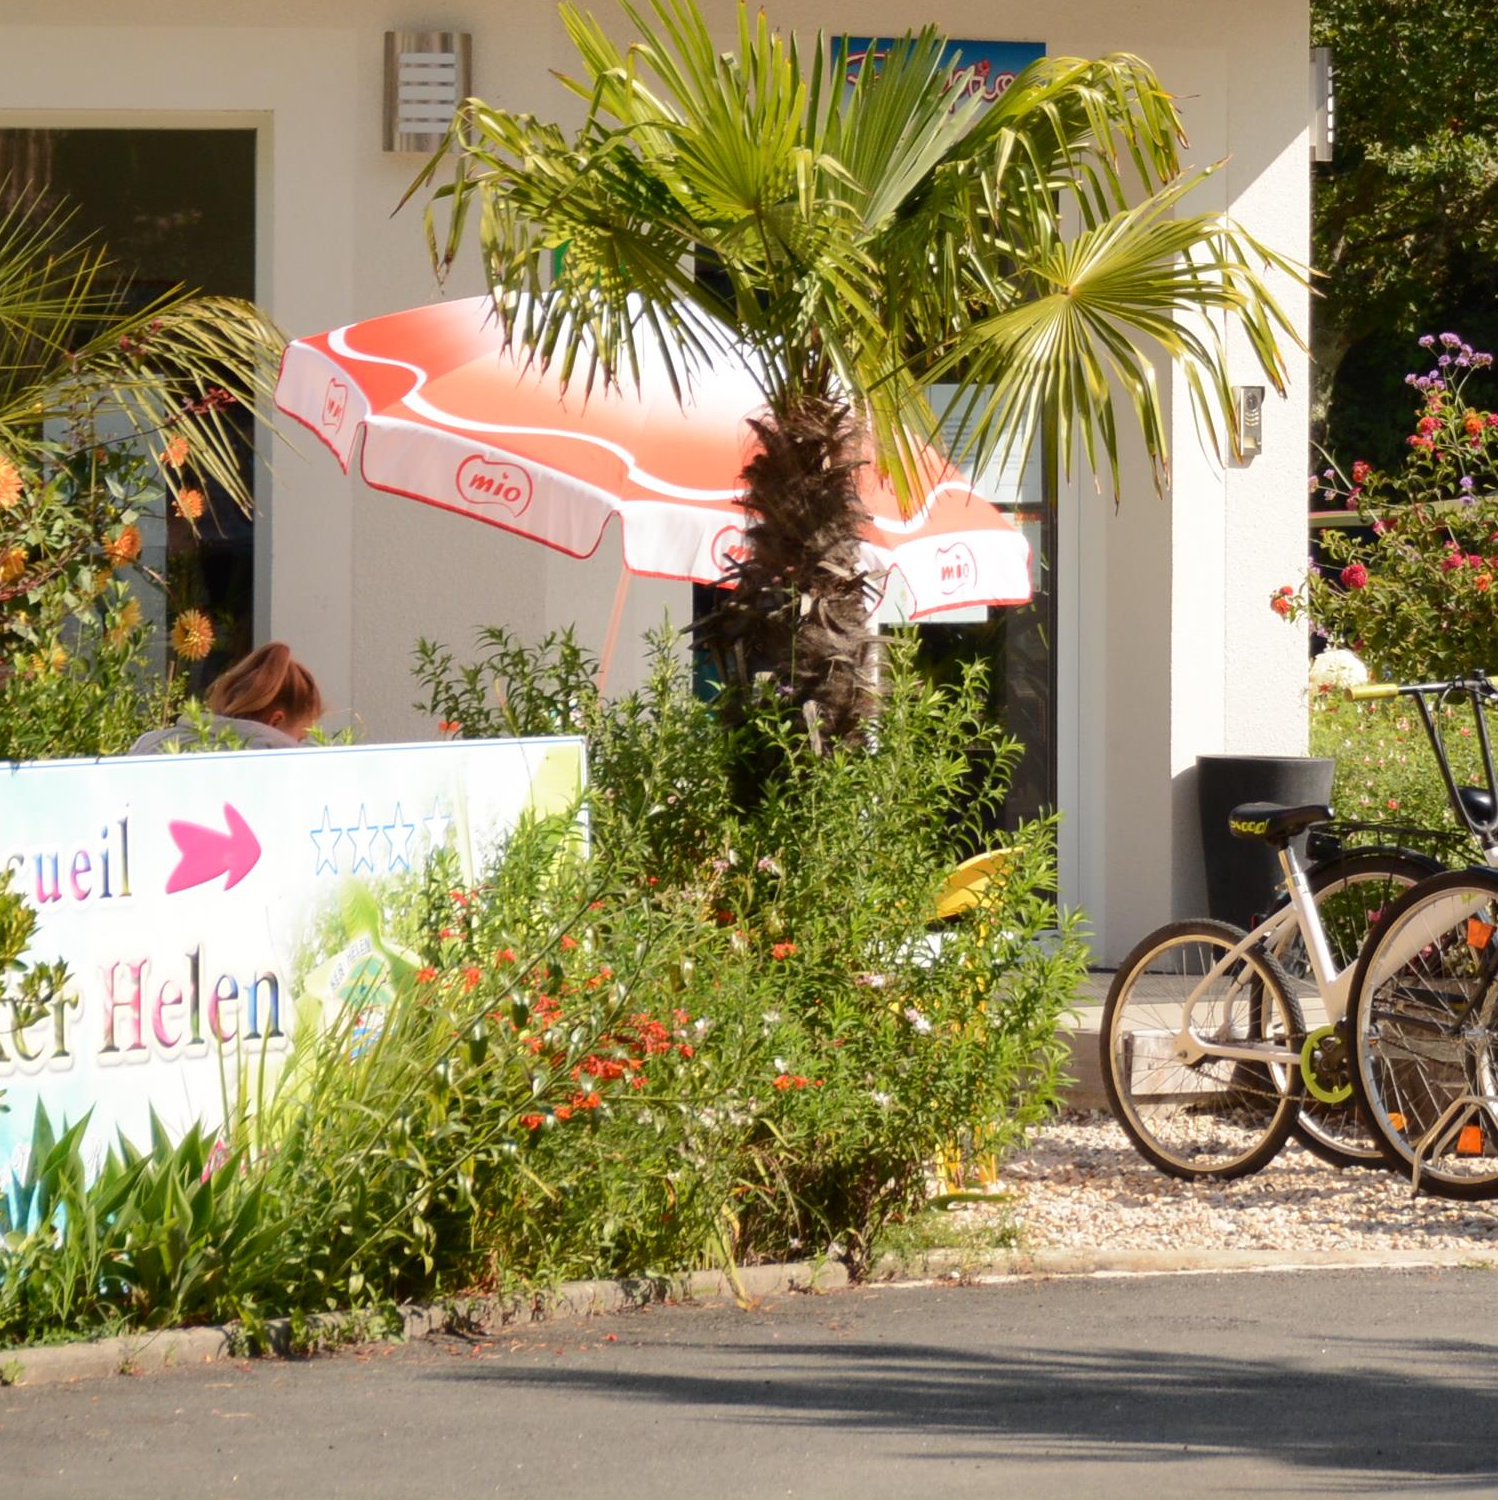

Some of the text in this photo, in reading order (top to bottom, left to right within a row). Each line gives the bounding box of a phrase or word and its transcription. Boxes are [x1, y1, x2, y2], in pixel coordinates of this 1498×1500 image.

[468, 471, 522, 503] mio
[941, 554, 970, 581] mio
[98, 942, 286, 1056] Helen
